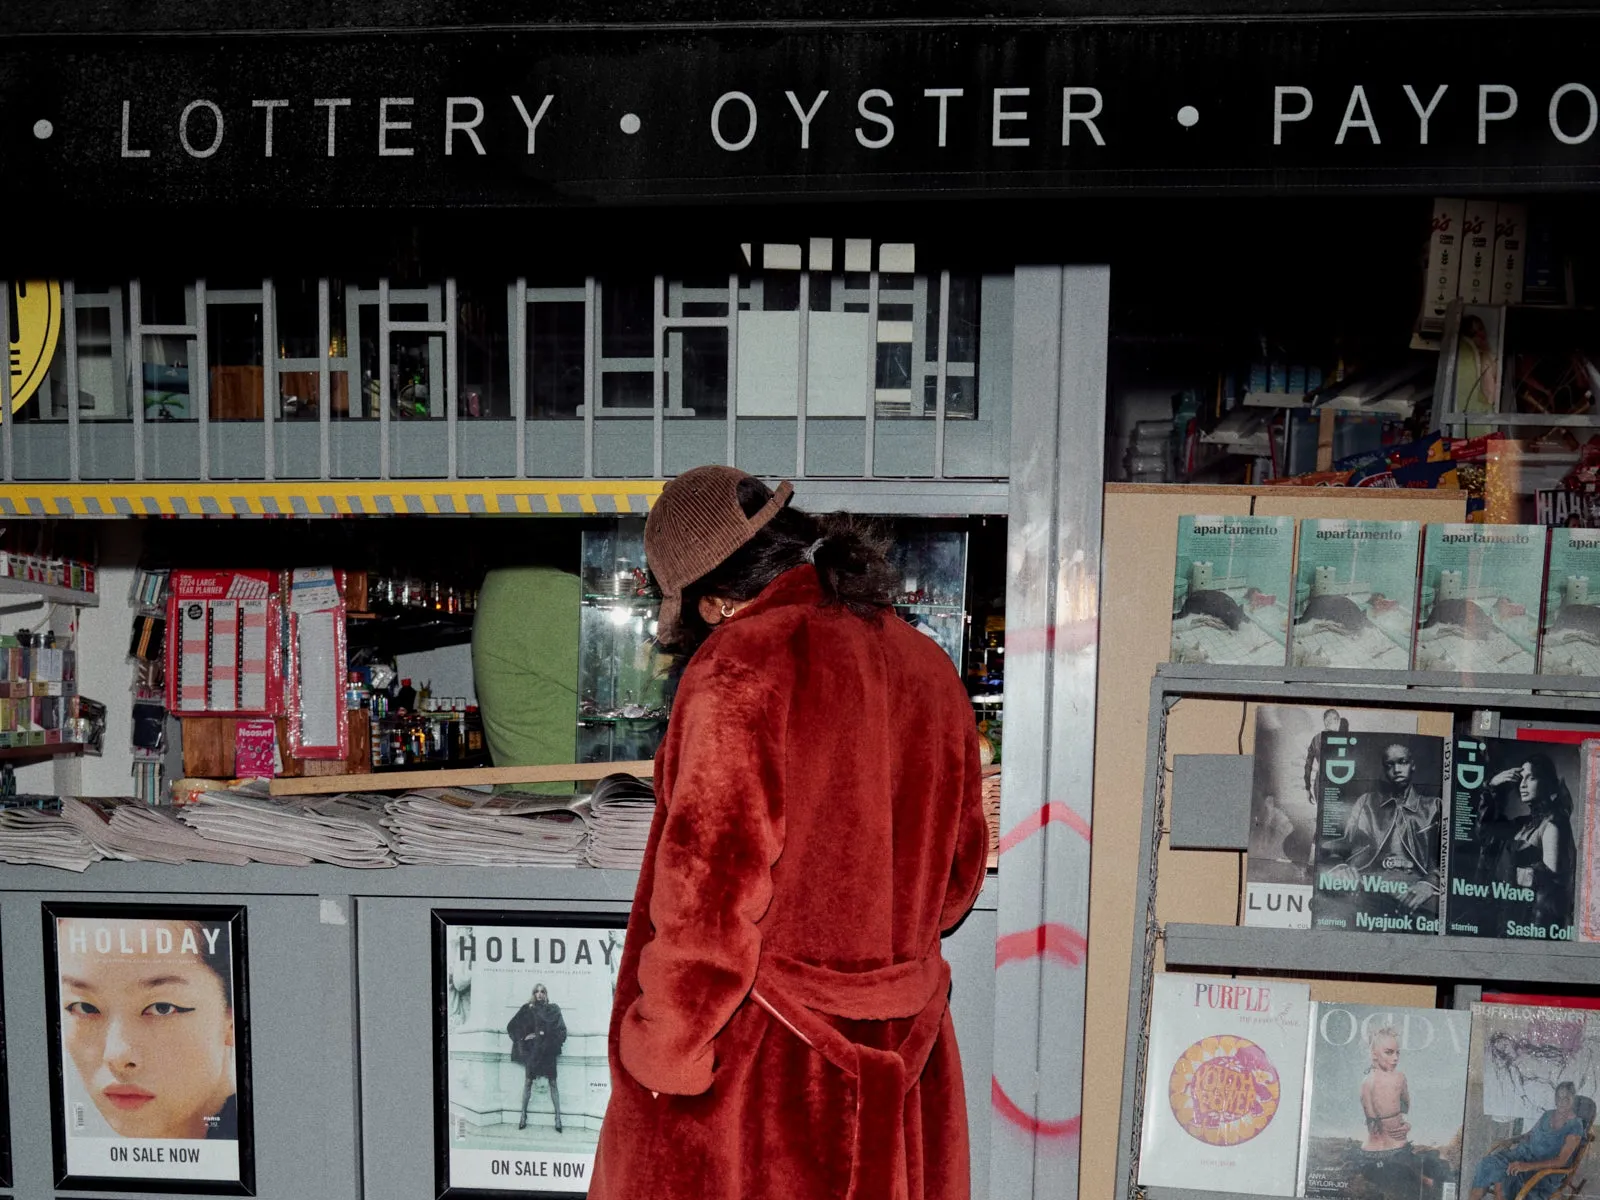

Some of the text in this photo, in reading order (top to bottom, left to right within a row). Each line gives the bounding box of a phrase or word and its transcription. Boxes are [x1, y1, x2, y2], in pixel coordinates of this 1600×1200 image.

[119, 81, 1600, 159] LOTTERY OYSTER PAYPO
[1193, 523, 1278, 537] apartamento
[1316, 528, 1403, 542] apartamento
[1442, 532, 1530, 545] apartamento
[180, 586, 223, 595] YEAR PLANNER
[197, 579, 217, 587] LARGE
[1326, 737, 1358, 785] i-D
[1457, 740, 1487, 790] i-D
[1319, 873, 1409, 895] New Wave
[1452, 878, 1535, 902] New Wave
[1317, 918, 1347, 928] starring
[1356, 912, 1412, 931] Nyajuok
[1451, 923, 1479, 934] starring
[1507, 920, 1547, 939] Sasha
[68, 927, 221, 955] HOLIDAY
[459, 936, 616, 966] HOLIDAY
[1194, 982, 1271, 1013] PURPLE
[110, 1146, 200, 1163] ON SALE NOW
[491, 1159, 585, 1178] ON SALE NOW
[1308, 1180, 1348, 1188] TAYLOR-JOY
